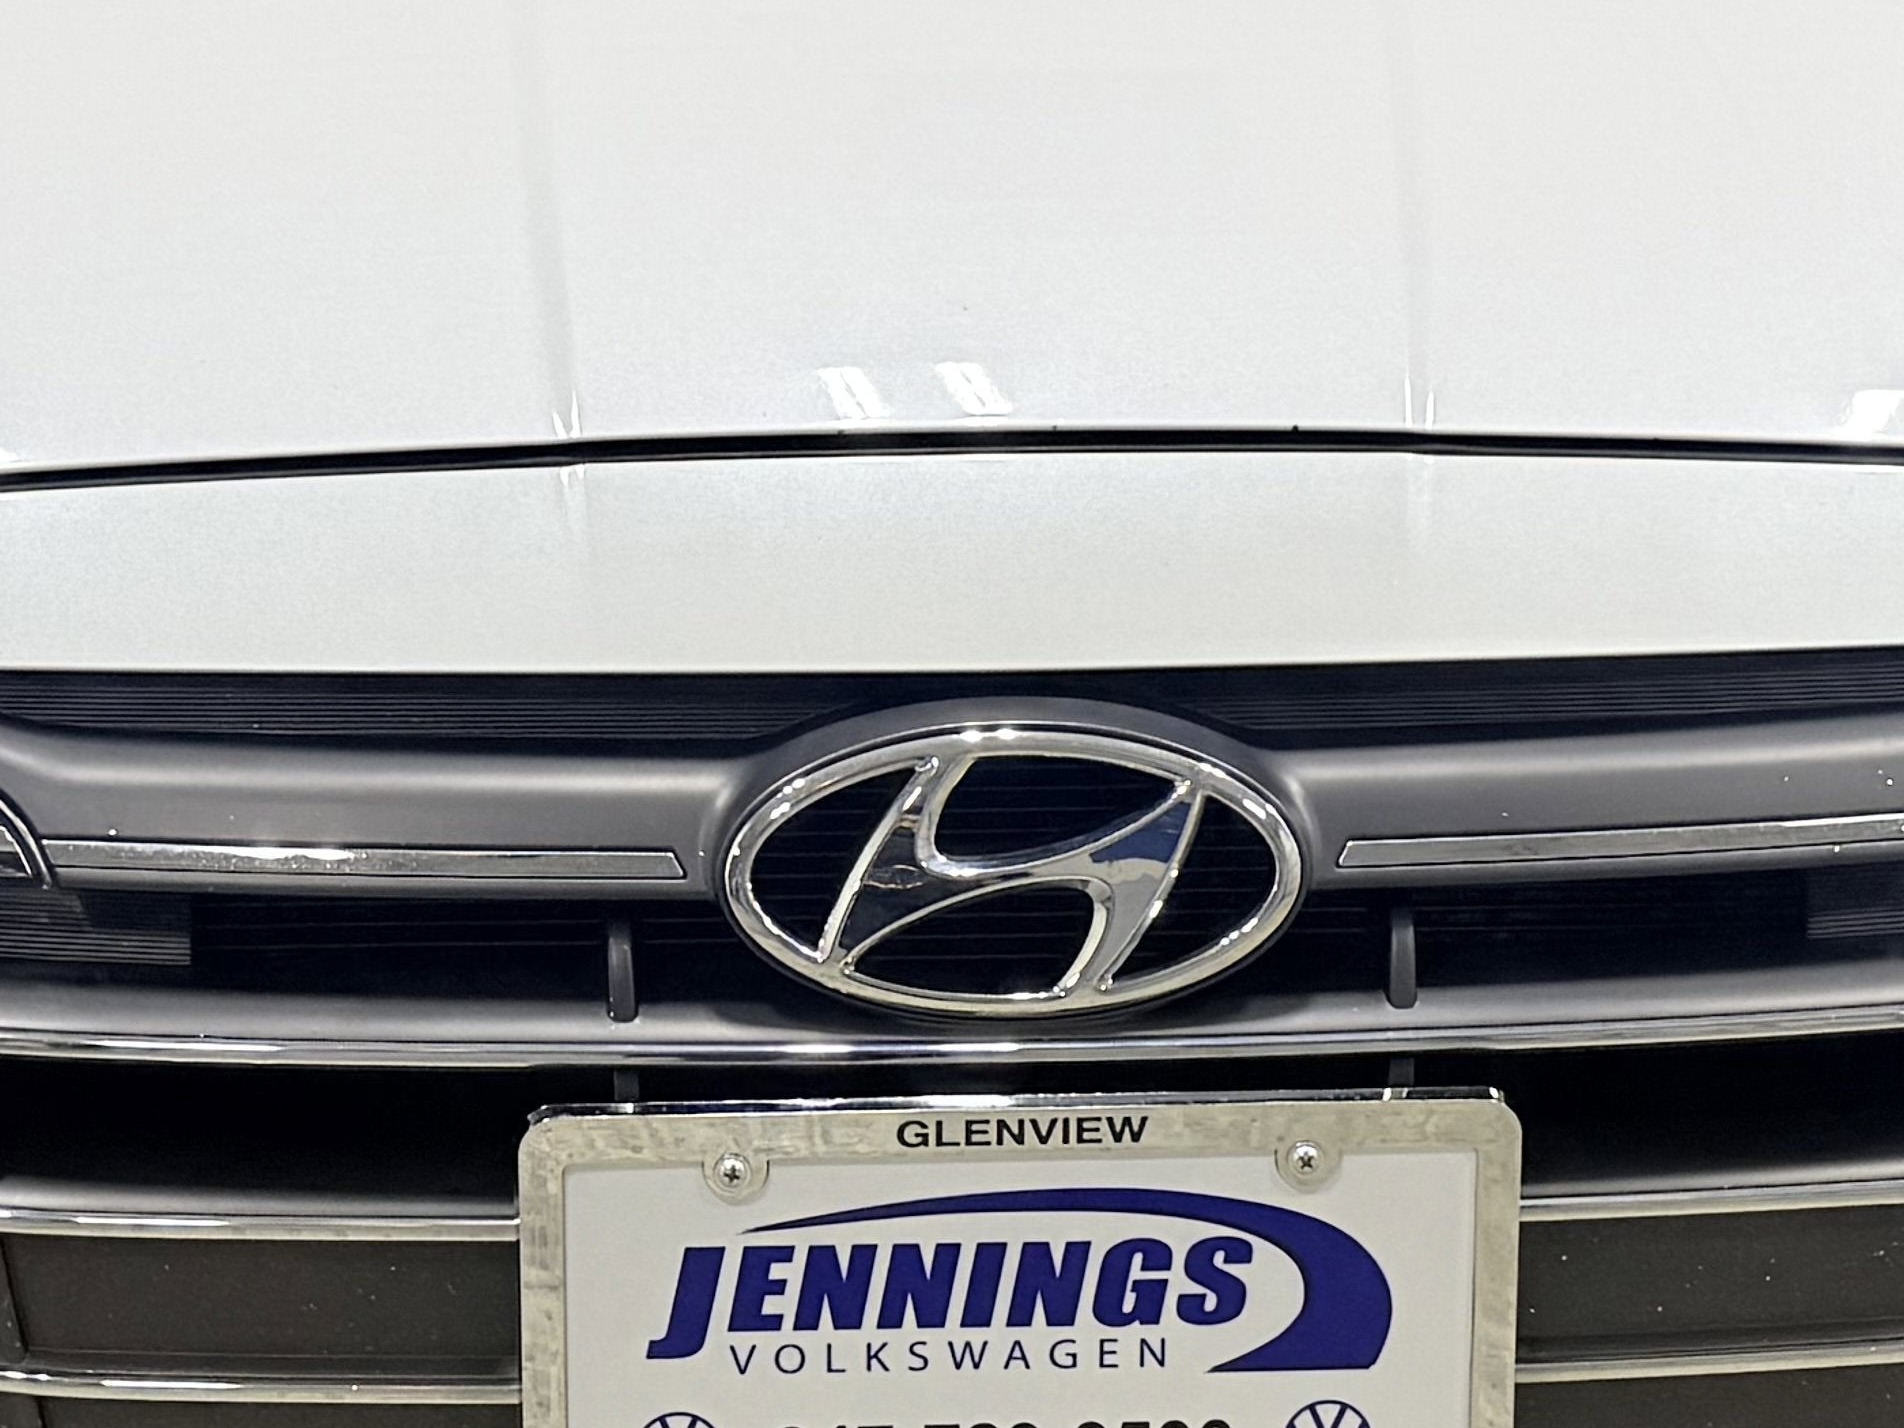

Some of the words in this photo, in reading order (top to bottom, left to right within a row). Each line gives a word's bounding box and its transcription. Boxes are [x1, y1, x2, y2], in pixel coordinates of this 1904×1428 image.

[896, 1115, 1150, 1149] GLENVIEW
[645, 1235, 1255, 1360] JENNINGS
[729, 1337, 1167, 1376] VOLKSWAGEN
